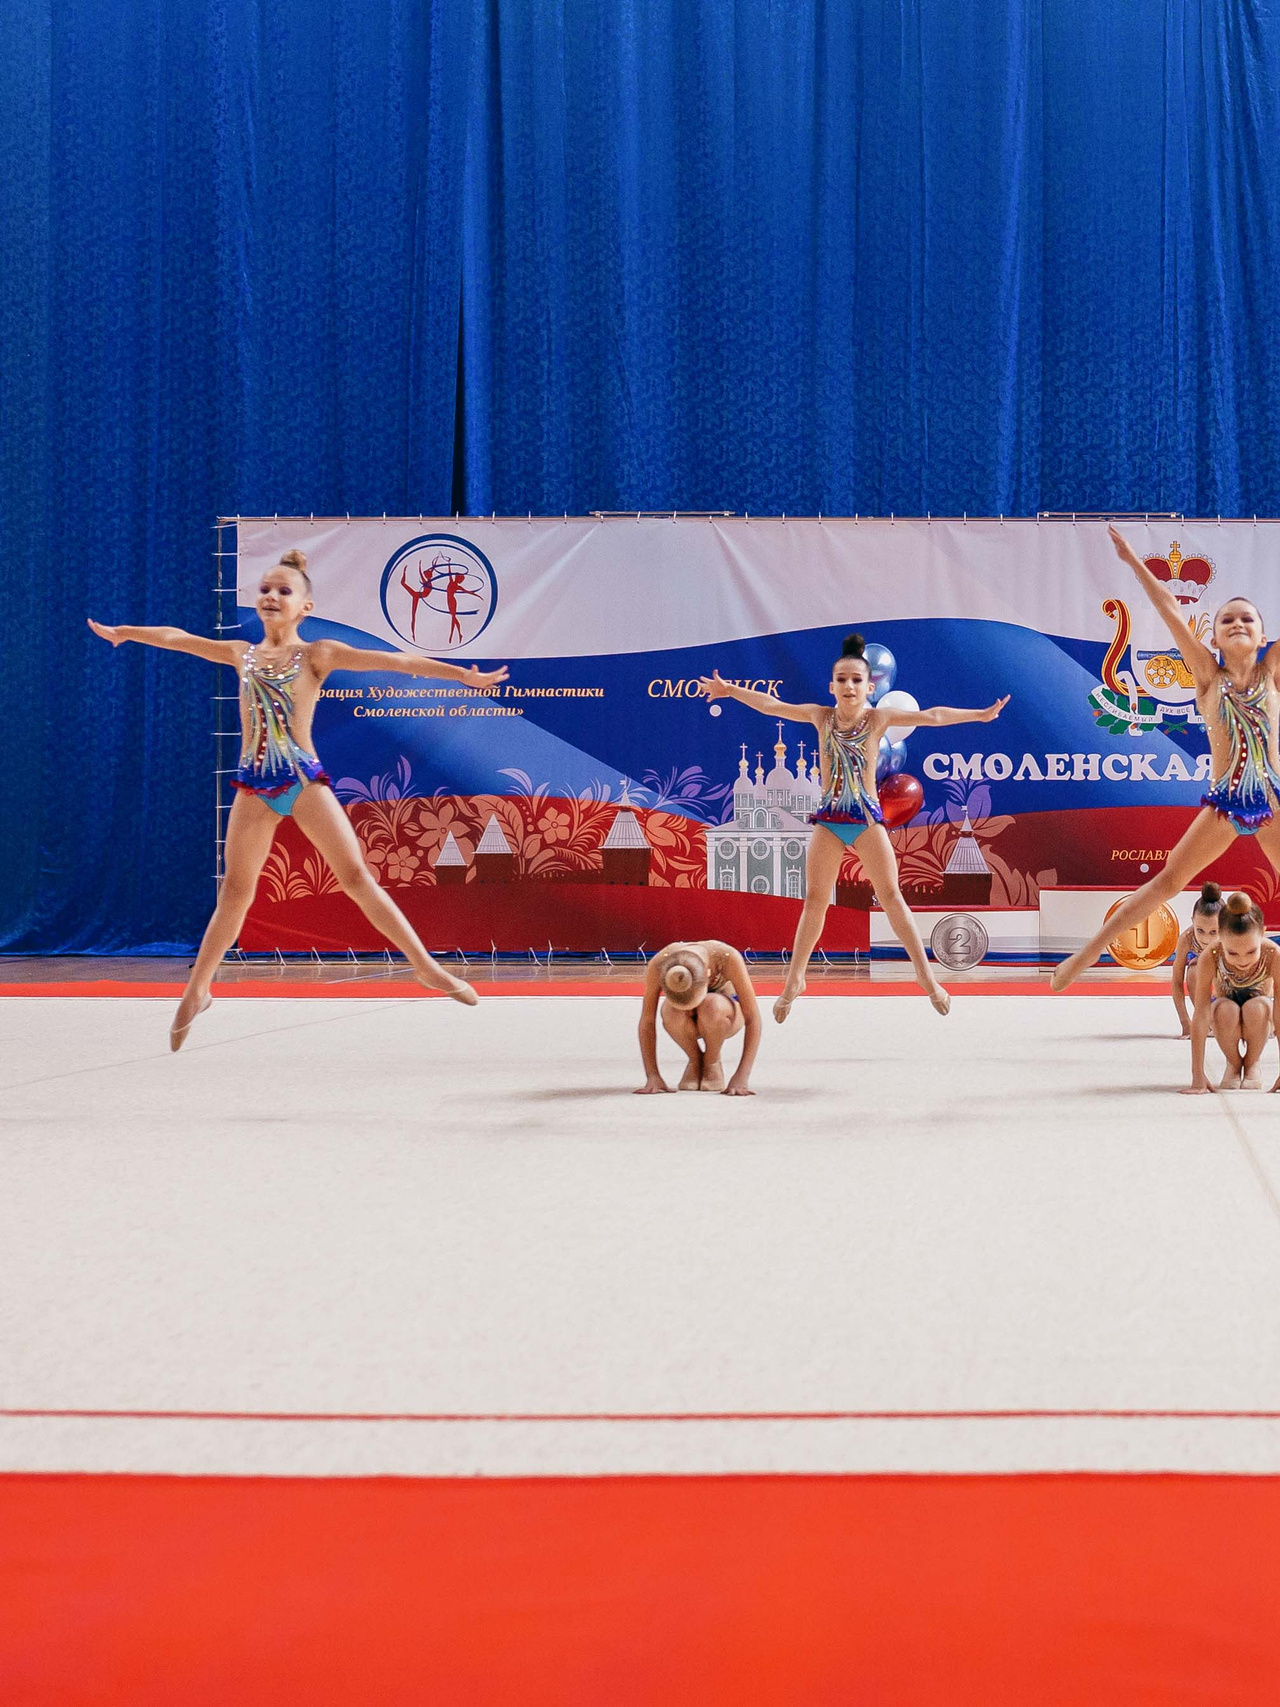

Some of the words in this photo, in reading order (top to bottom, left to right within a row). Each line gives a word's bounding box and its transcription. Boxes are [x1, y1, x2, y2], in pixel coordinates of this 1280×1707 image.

[318, 687, 363, 702] рация
[366, 685, 500, 702] Художественной
[504, 685, 605, 698] Гимнастики
[353, 704, 446, 718] Смоленской
[449, 705, 524, 717] области»
[923, 752, 1214, 782] СМОЛЕНСКАЯ
[1111, 849, 1172, 861] РОСЛАВЛ
[949, 926, 972, 955] 2
